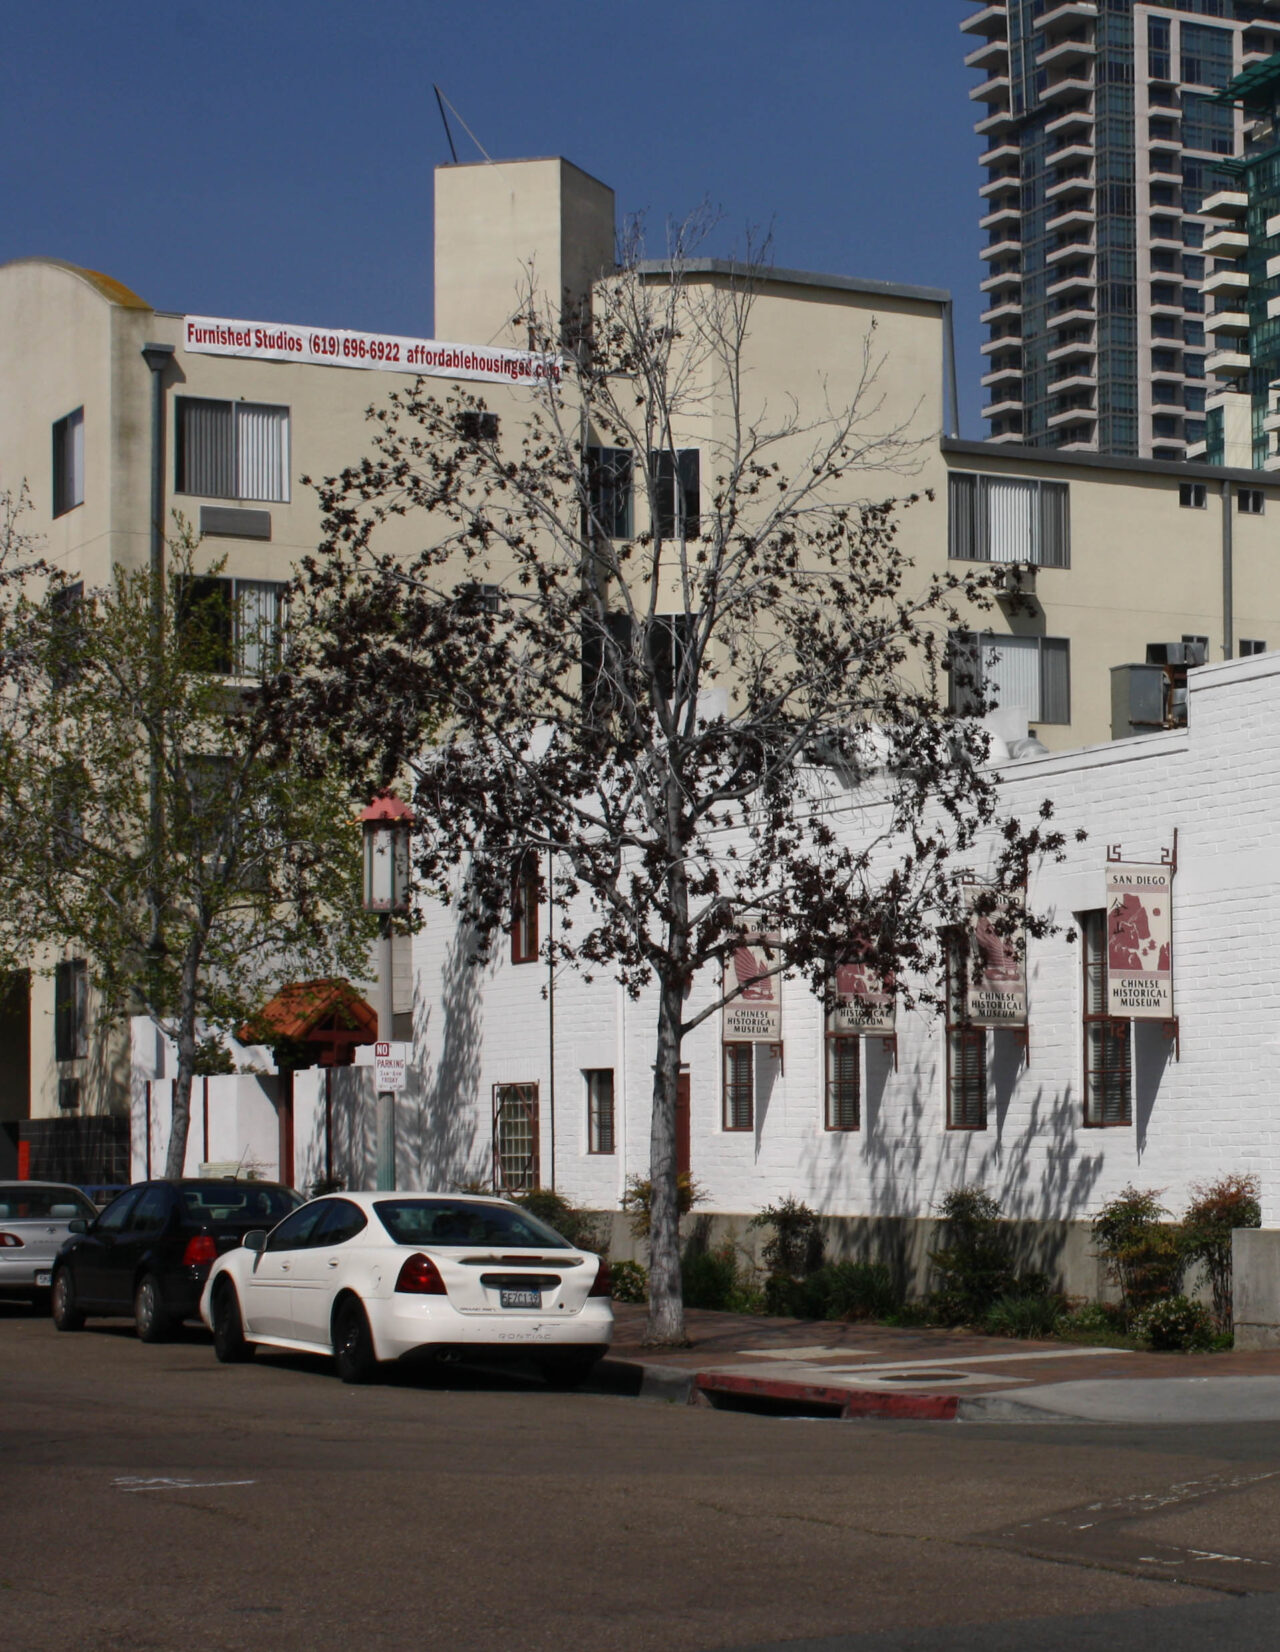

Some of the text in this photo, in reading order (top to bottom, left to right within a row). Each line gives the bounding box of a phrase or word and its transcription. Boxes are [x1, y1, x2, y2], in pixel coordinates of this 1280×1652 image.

[188, 323, 252, 347] Furnished
[255, 329, 303, 352] Studios
[308, 333, 340, 357] (619)
[343, 338, 400, 362] 696-6922
[1113, 875, 1166, 885] SAN DIEGO
[1121, 979, 1160, 989] CHINESE
[979, 992, 1015, 1001] CHINESE
[1113, 988, 1168, 998] HISTORICAL
[971, 1000, 1022, 1010] HISTORICAL
[1121, 998, 1161, 1007] MUSEUM
[734, 1010, 769, 1018] CHINESE
[979, 1009, 1016, 1018] MUSEUM
[727, 1017, 776, 1026] HISTORICAL
[734, 1025, 769, 1033] MUSEUM
[377, 1044, 388, 1055] NO
[377, 1060, 404, 1069] PARKING
